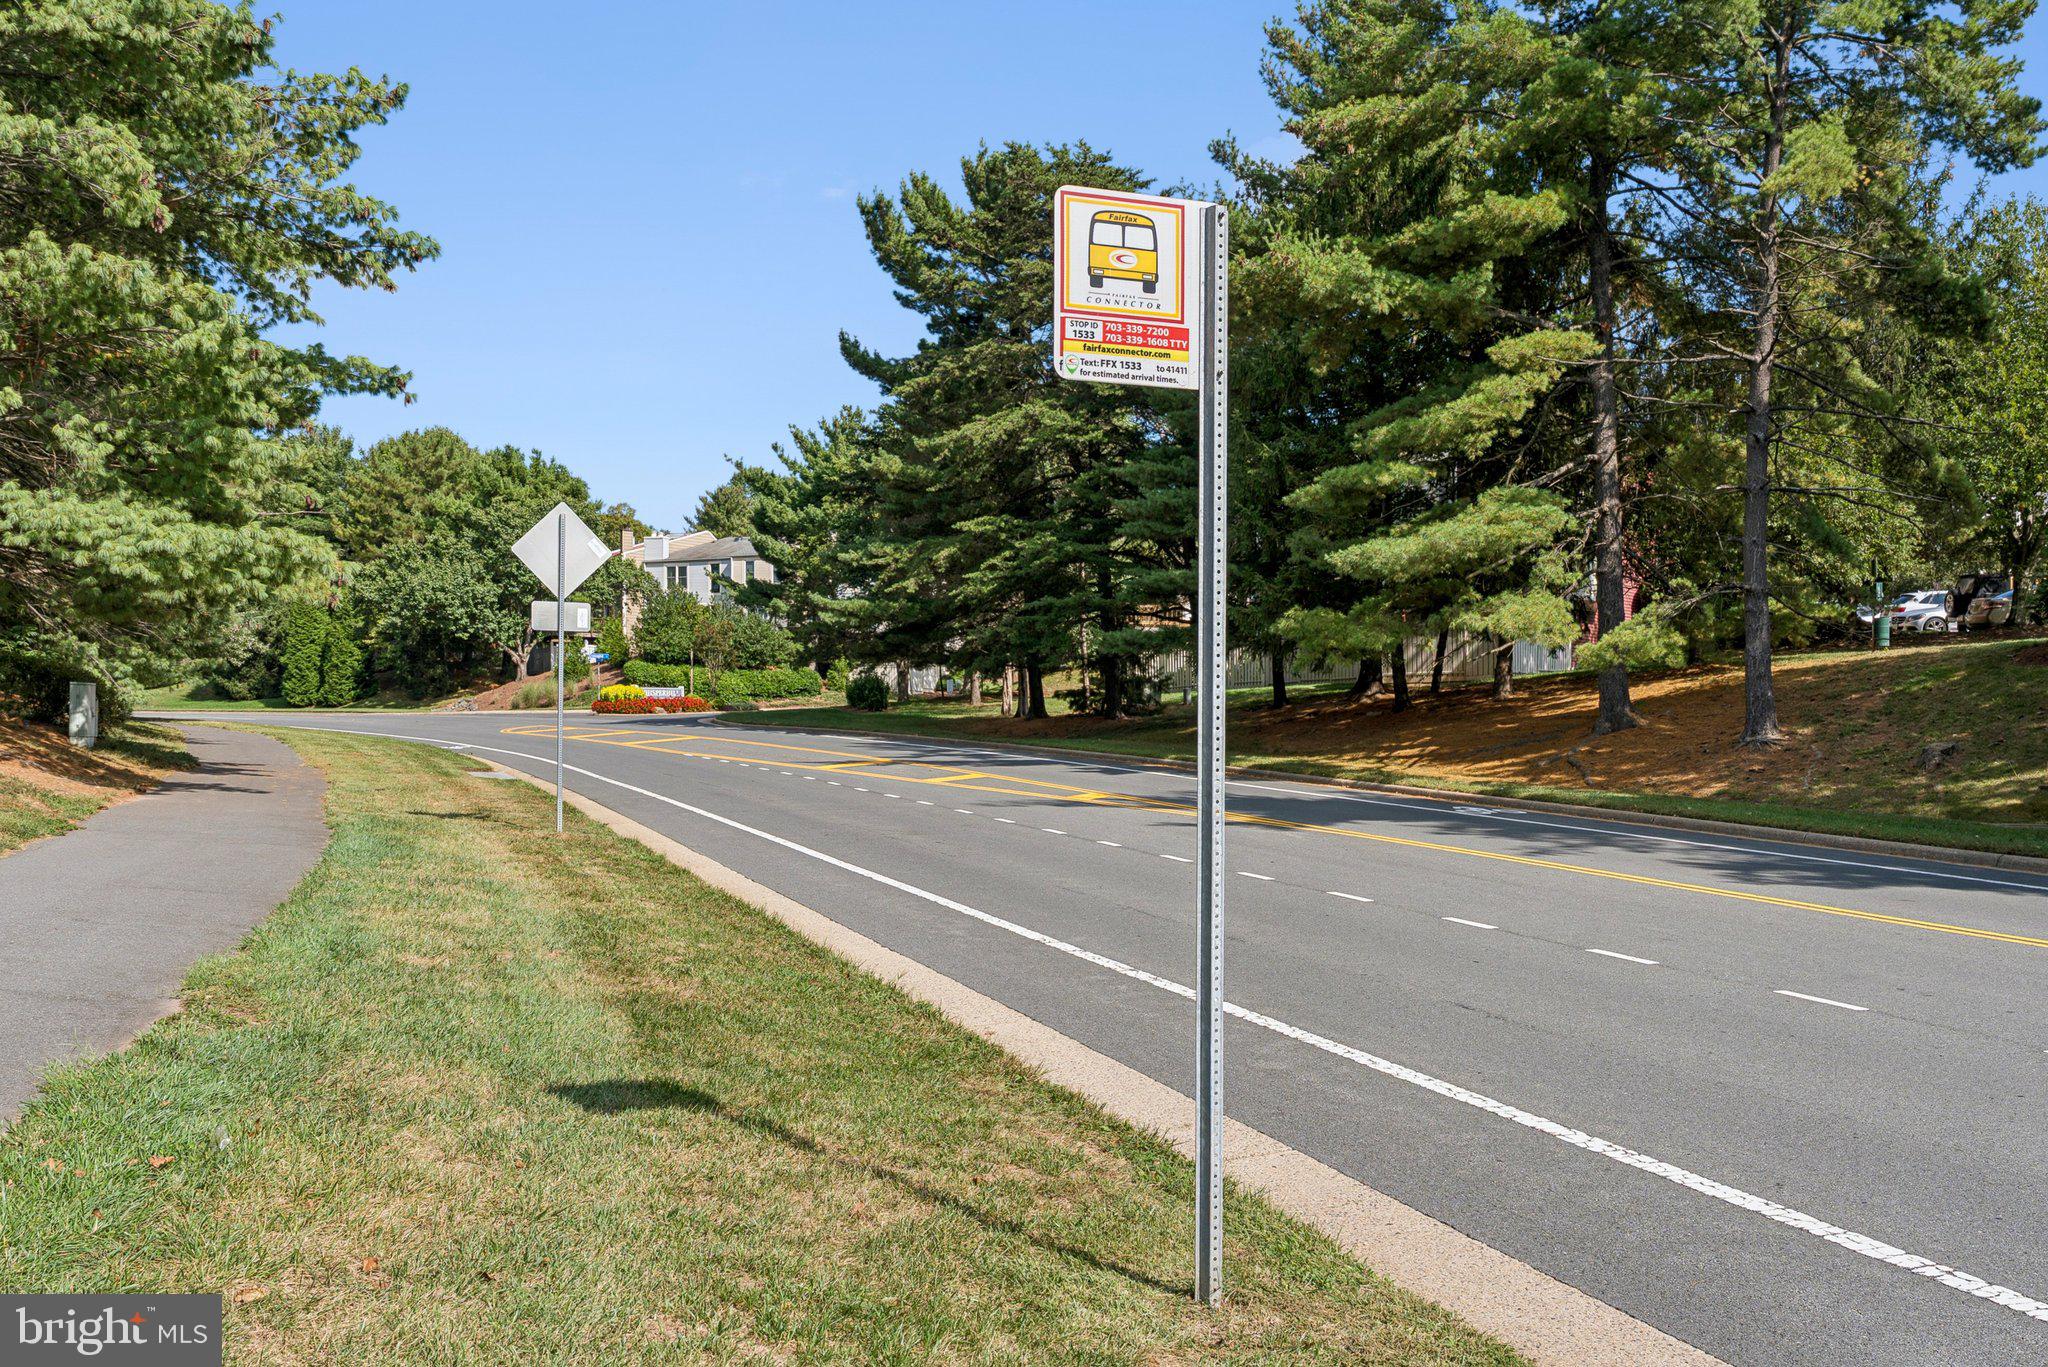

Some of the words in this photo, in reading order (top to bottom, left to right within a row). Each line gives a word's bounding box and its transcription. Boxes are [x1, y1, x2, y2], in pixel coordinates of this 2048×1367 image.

[1109, 213, 1138, 223] Fairfax
[1086, 296, 1162, 310] CONNECTOR
[1070, 320, 1090, 328] STOP
[1090, 321, 1099, 329] ID
[1105, 322, 1169, 337] 703-339-7200
[1072, 329, 1096, 339] 1533
[1105, 334, 1169, 347] 703-339-1608
[1170, 340, 1188, 349] TTY
[1083, 343, 1171, 359] fairfaxconnector.com
[1080, 358, 1100, 368] Text:
[1100, 360, 1117, 369] FFX
[1120, 361, 1142, 371] 1533
[1156, 365, 1165, 373] to
[1166, 366, 1188, 375] 41411
[1080, 368, 1091, 377] for
[1092, 369, 1130, 380] estimated
[1131, 373, 1155, 382] arrival
[1156, 374, 1179, 384] times.
